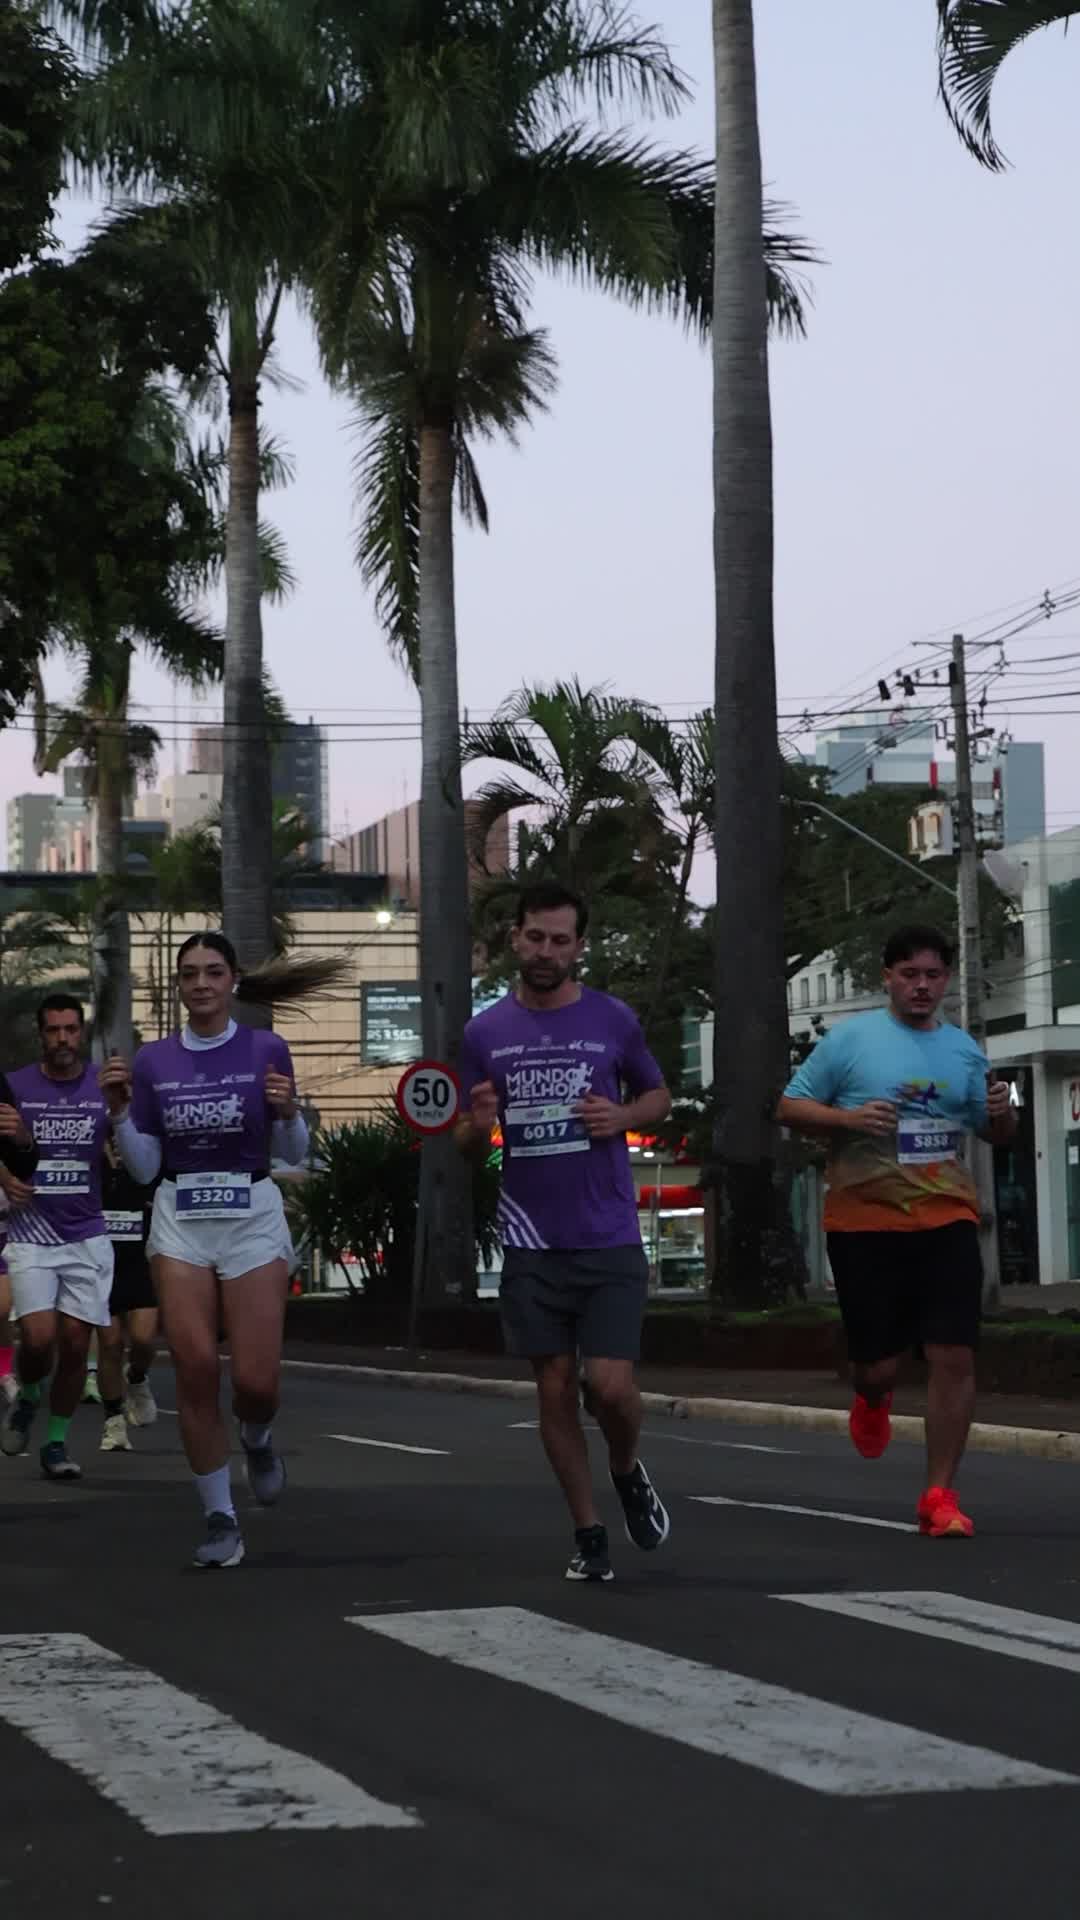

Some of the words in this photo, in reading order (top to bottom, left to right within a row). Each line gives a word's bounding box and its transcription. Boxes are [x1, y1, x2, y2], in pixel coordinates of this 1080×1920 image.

[506, 1067, 583, 1086] MUNDO
[412, 1077, 450, 1108] 50
[163, 1100, 232, 1119] MUNDO
[33, 1119, 89, 1131] MUNDO
[523, 1121, 568, 1140] 6017
[47, 1172, 79, 1182] 5113
[192, 1188, 235, 1203] 5320
